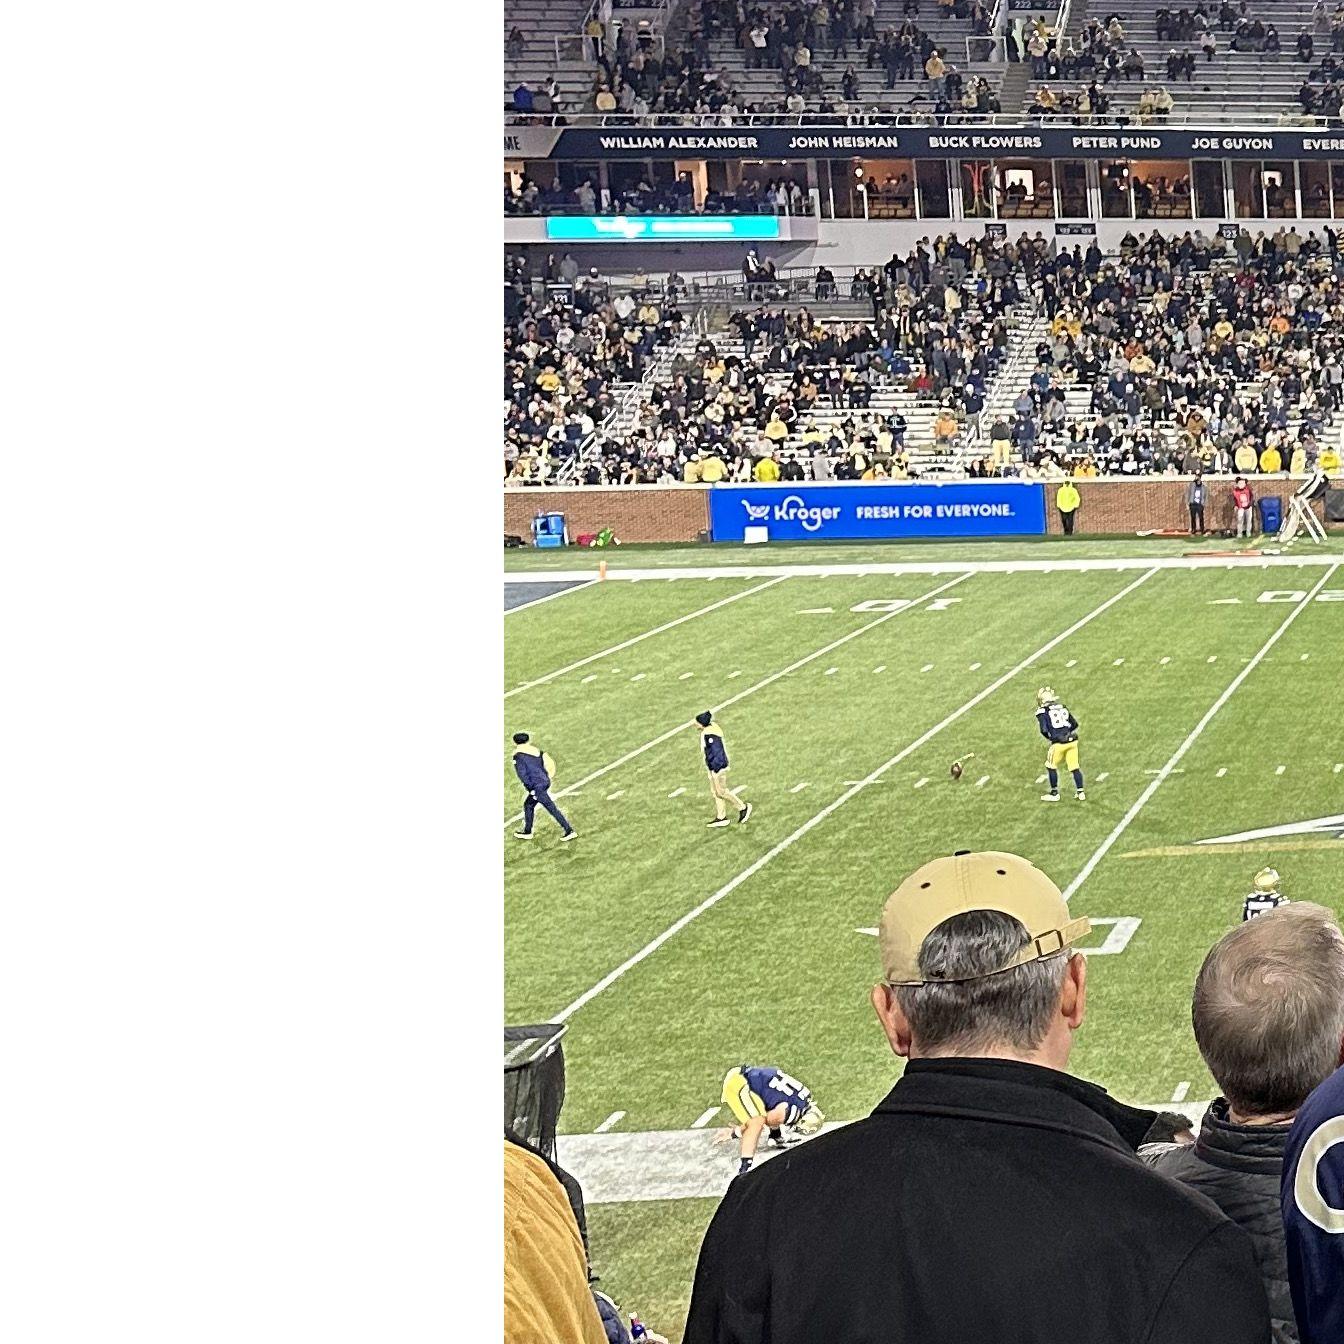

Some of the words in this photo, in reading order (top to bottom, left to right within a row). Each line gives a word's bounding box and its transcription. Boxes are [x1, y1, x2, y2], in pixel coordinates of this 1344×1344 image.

[599, 136, 665, 149] WILLIAM
[668, 136, 758, 149] ALEXANDER
[788, 136, 830, 149] JOHN
[832, 136, 898, 149] HEISMAN
[928, 136, 970, 148] BUCK
[971, 136, 1042, 148] FLOWERS
[1072, 136, 1119, 149] PETER
[1120, 136, 1162, 149] PUND
[1191, 137, 1220, 150] JOE
[1222, 137, 1273, 150] GUYON
[774, 495, 841, 532] Kroger
[855, 505, 900, 519] FRESH
[903, 504, 933, 518] FOR
